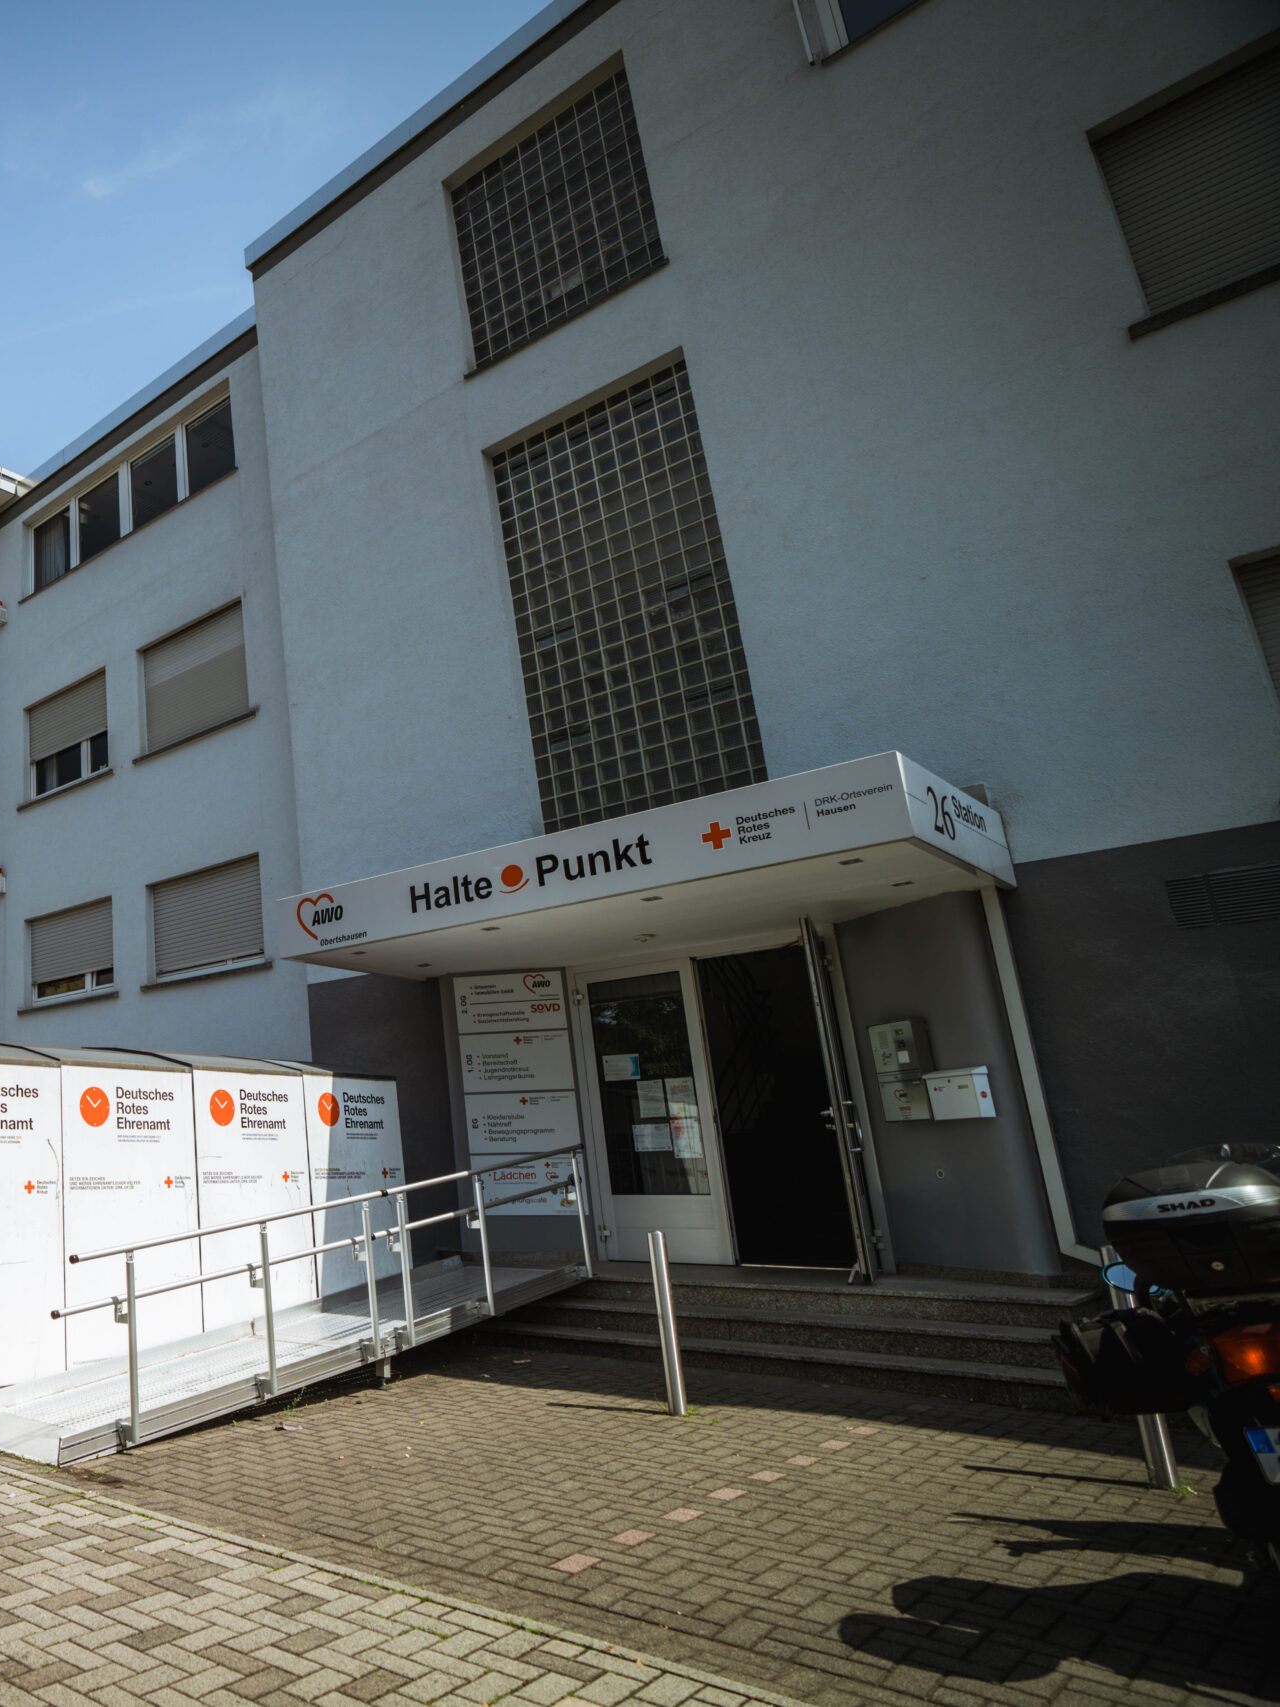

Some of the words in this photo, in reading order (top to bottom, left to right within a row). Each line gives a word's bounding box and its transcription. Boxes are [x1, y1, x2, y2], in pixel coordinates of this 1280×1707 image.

[814, 783, 893, 807] DRK-Ortsverein
[735, 805, 795, 826] Deutsches
[816, 802, 856, 818] Hausen
[927, 786, 956, 841] 26
[952, 795, 987, 833] Station
[737, 821, 770, 835] Rotes
[739, 830, 772, 845] Kreuz
[409, 875, 493, 914] Halte
[536, 833, 652, 888] Punkt
[312, 905, 343, 927] AWO
[320, 931, 368, 946] Obertshausen
[532, 980, 551, 988] AWO
[116, 1086, 174, 1102] Deutsches
[239, 1089, 288, 1103] Deutsches
[343, 1092, 385, 1104] Deutsches
[117, 1102, 148, 1115] Rotes
[240, 1103, 267, 1116] Rotes
[344, 1105, 368, 1116] Rotes
[117, 1117, 170, 1131] Ehrenamt
[241, 1117, 286, 1130] Ehrenamt
[345, 1118, 384, 1129] Ehrenamt
[493, 1171, 537, 1182] Lädchen
[1157, 1199, 1215, 1213] SHAD
